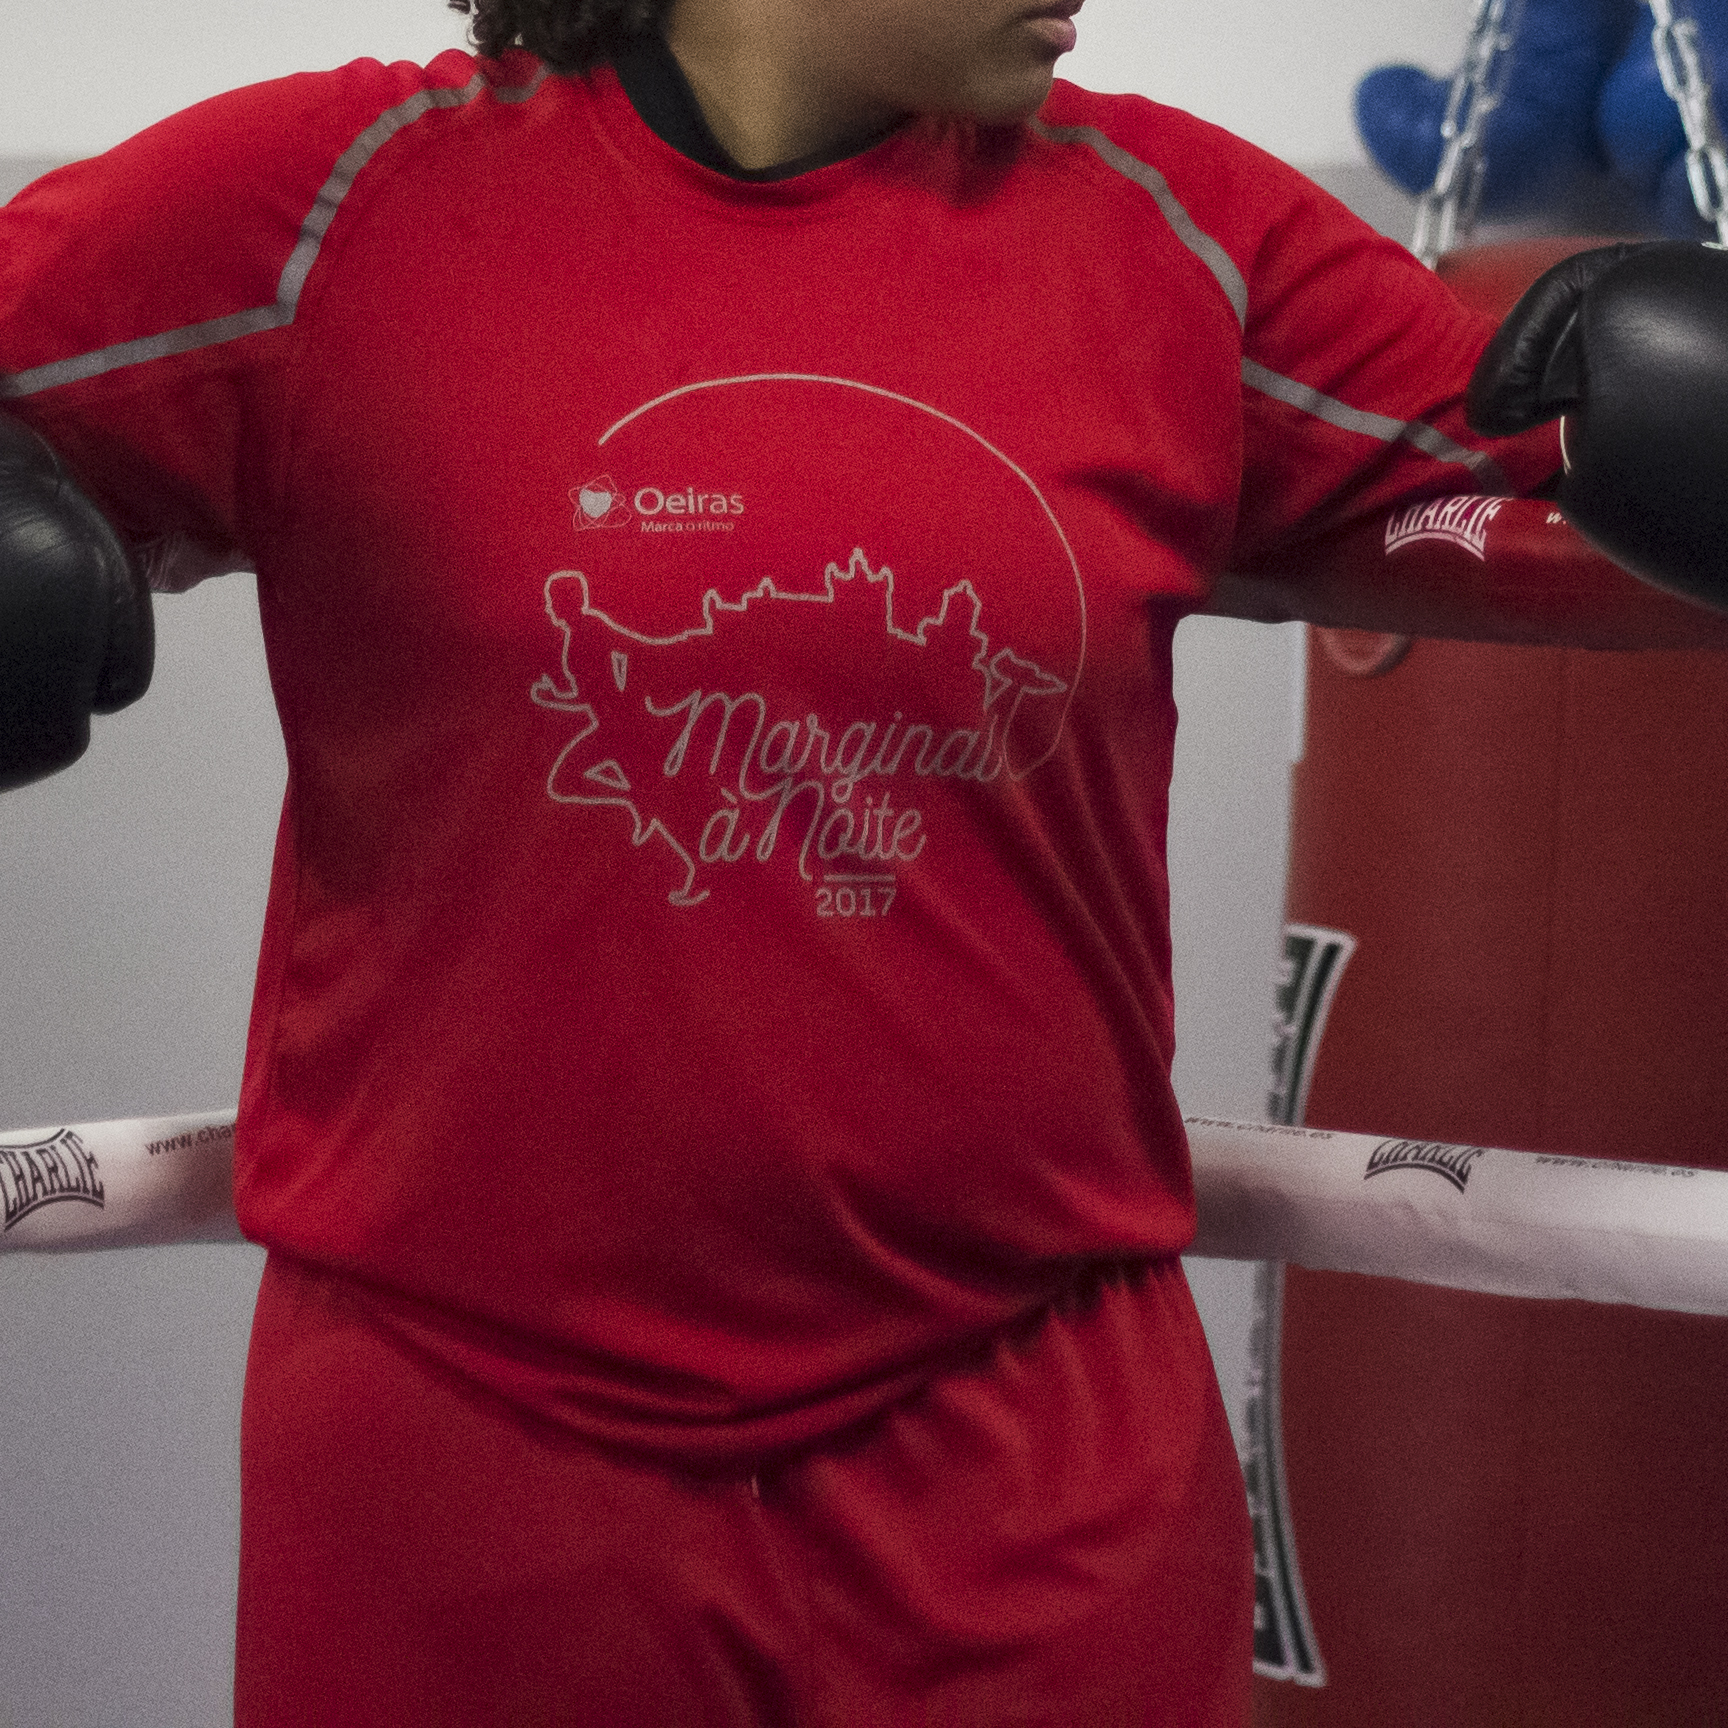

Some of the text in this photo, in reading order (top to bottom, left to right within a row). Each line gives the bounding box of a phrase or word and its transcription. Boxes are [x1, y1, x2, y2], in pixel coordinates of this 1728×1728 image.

[634, 486, 745, 515] Oeiras
[646, 688, 1004, 802] Marginal
[816, 887, 897, 917] 2017
